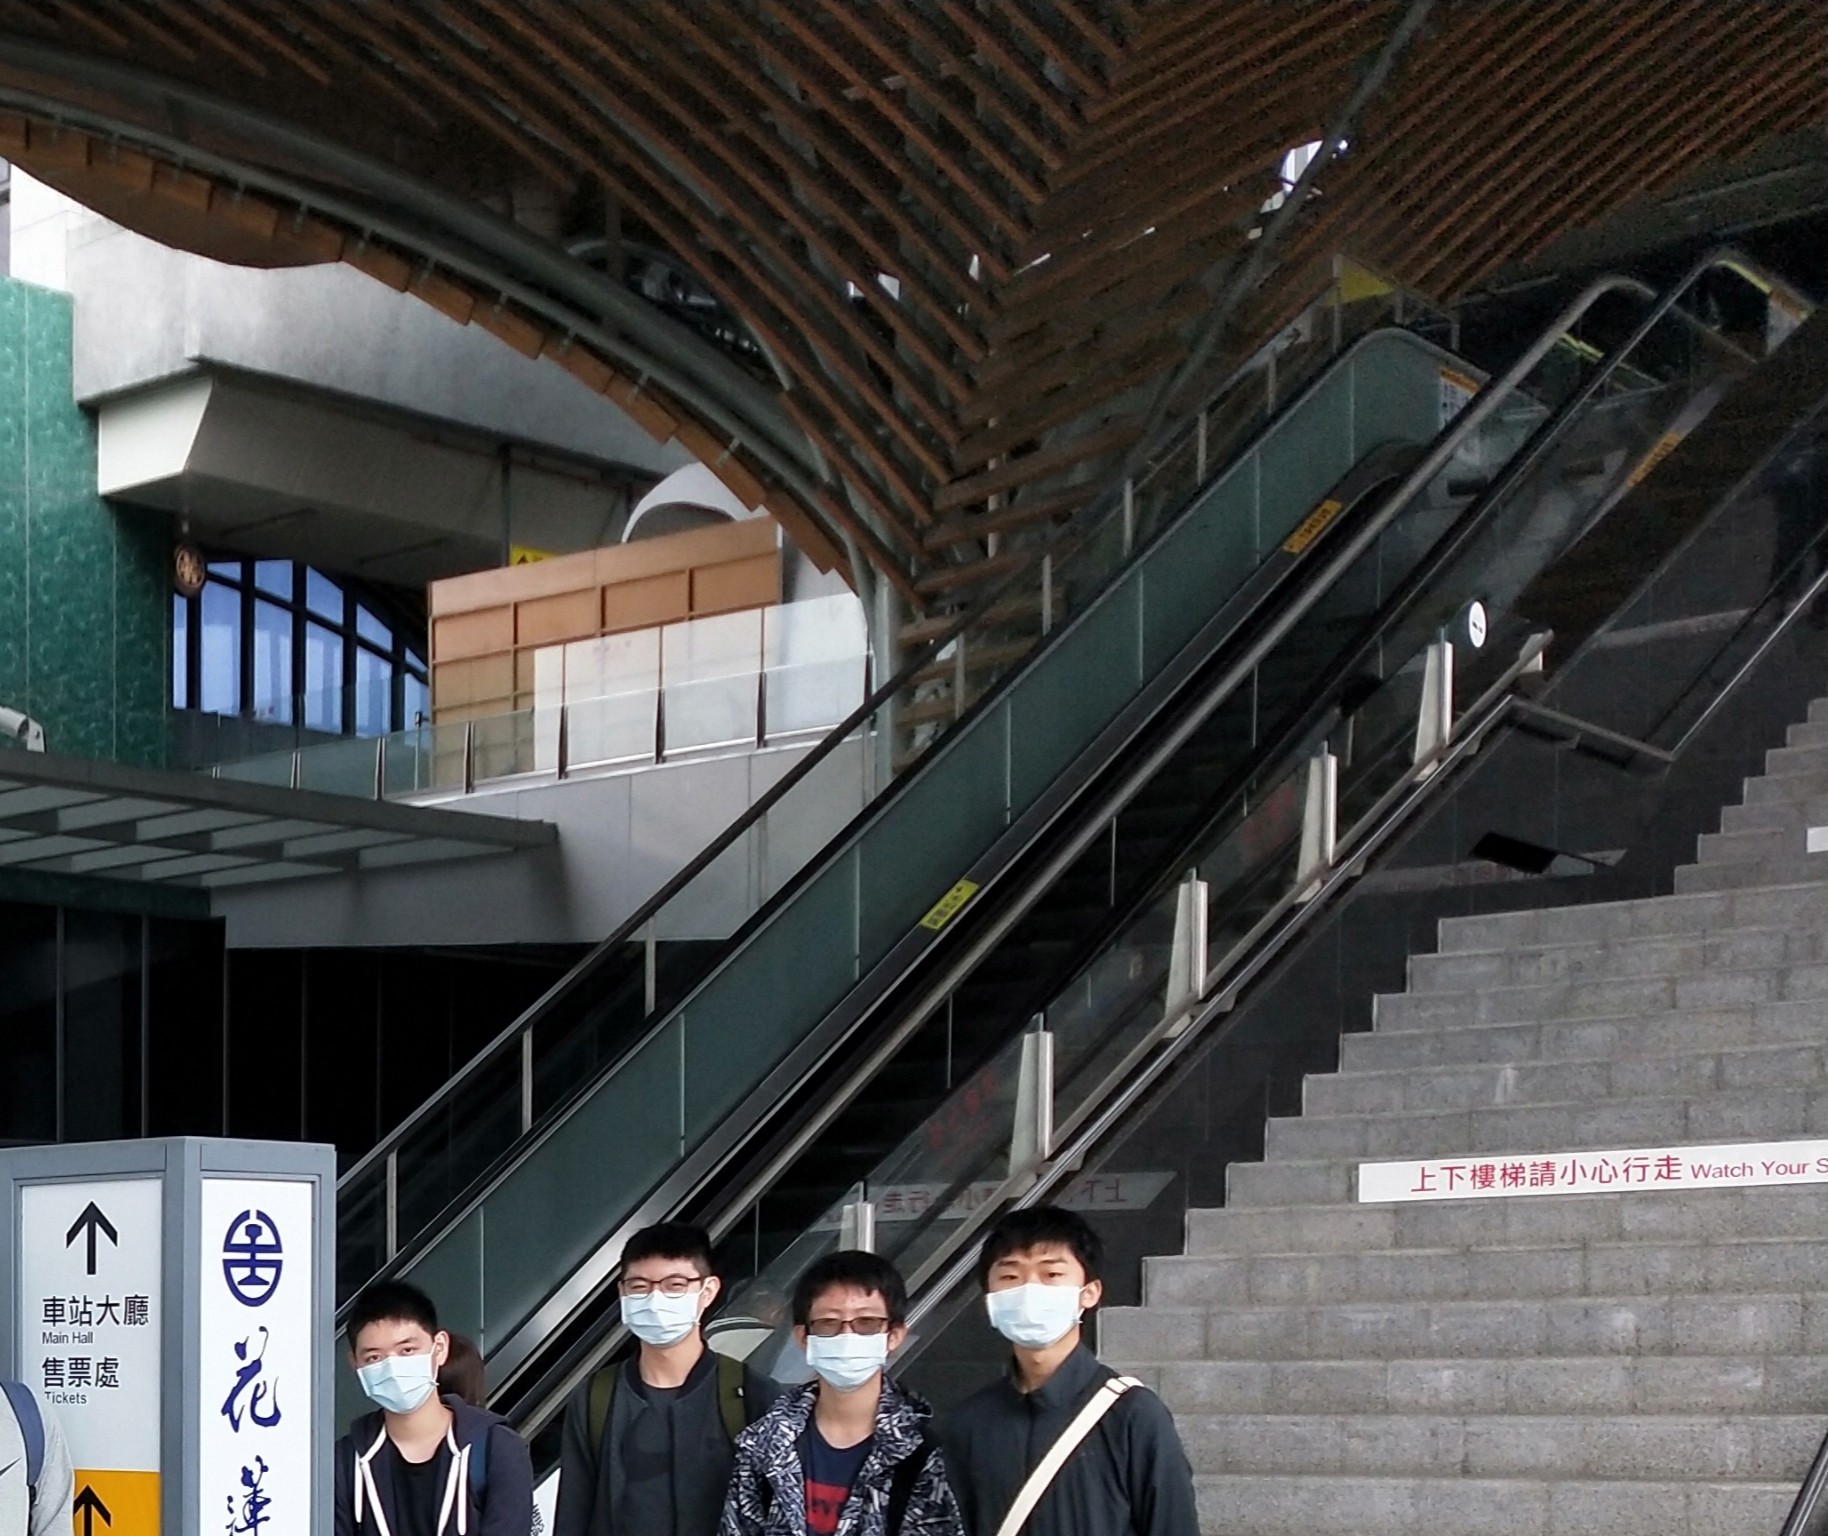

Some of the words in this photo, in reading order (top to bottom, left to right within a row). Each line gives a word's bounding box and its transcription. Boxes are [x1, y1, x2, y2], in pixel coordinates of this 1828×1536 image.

[1411, 1154, 1683, 1193] 上下樓梯請小心行走
[1690, 1162, 1754, 1180] Watch
[1760, 1160, 1810, 1177] Your
[42, 1294, 150, 1327] 車站大廳
[42, 1331, 70, 1345] Main
[71, 1332, 94, 1345] Hall
[41, 1356, 120, 1389] 售票處
